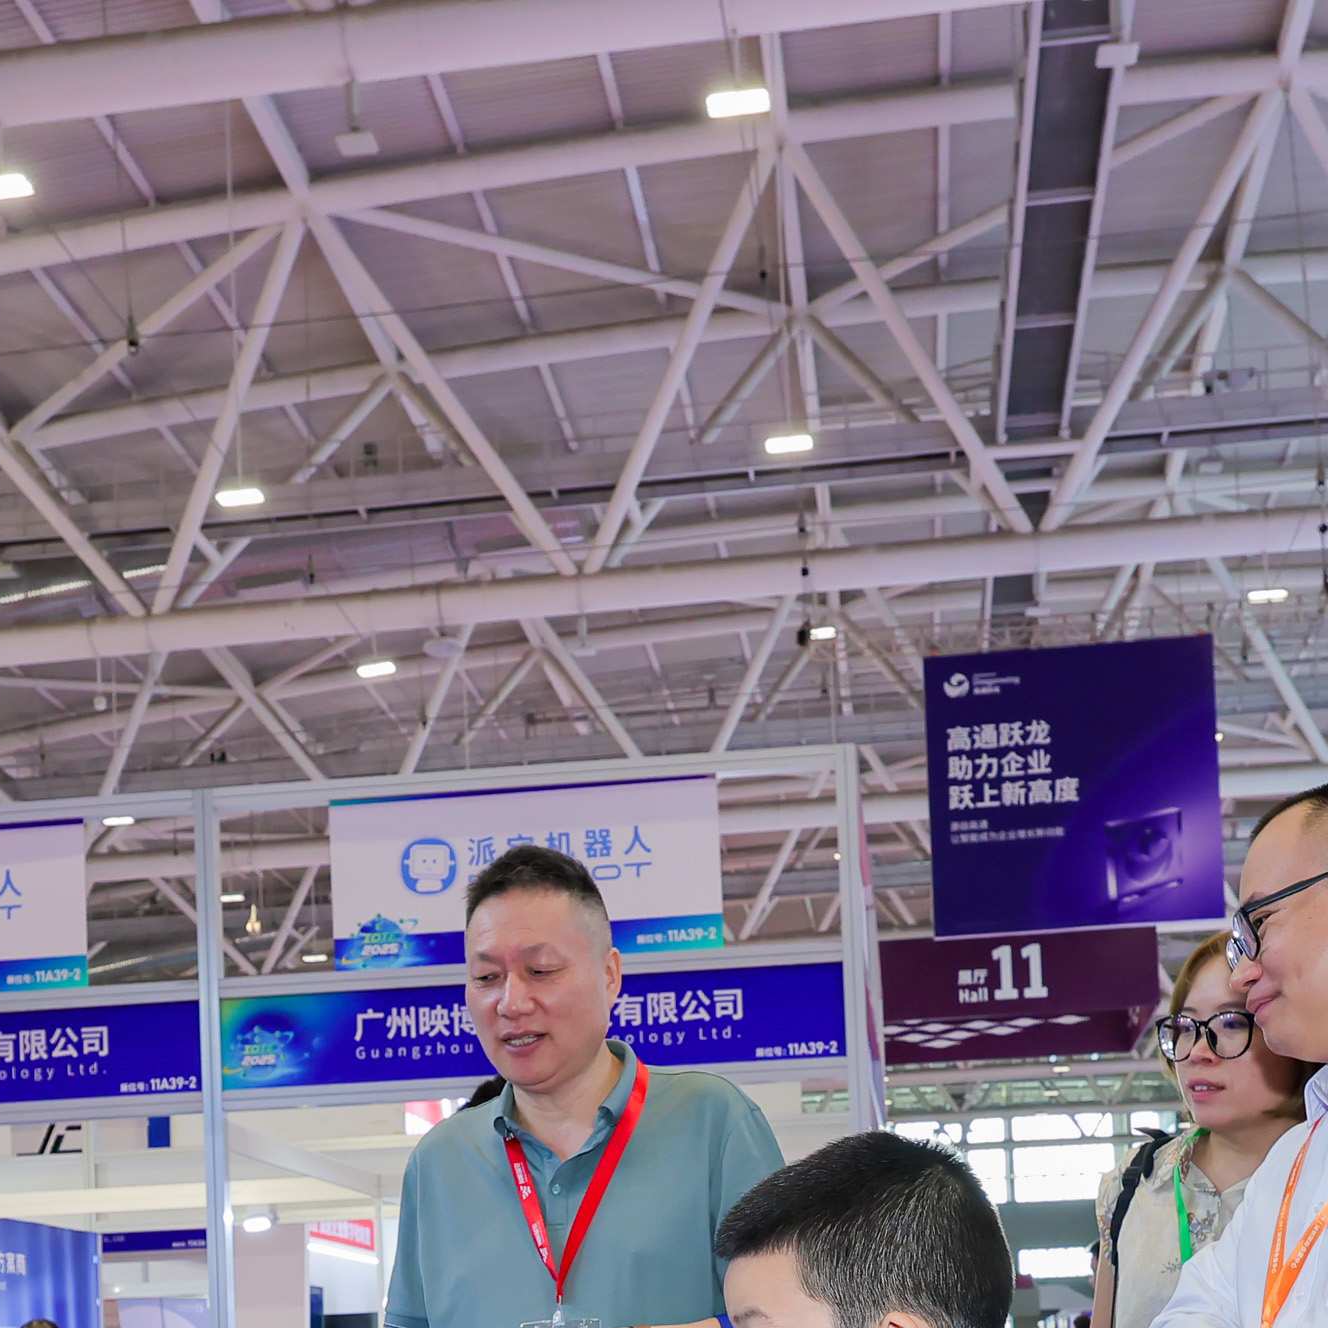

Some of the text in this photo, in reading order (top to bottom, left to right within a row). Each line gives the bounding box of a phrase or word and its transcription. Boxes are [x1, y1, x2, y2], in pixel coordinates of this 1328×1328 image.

[946, 719, 1052, 752] 高通跃龙
[947, 748, 1053, 781] 助力企业
[948, 776, 1080, 811] 跃上新高度
[668, 926, 719, 945] 11A39-2
[34, 967, 83, 985] 11A39-2
[990, 942, 1049, 1001] 11
[609, 988, 744, 1028] 有限公司
[958, 986, 989, 1004] Hall
[355, 1042, 474, 1060] Guangzhou
[698, 1025, 743, 1041] Ltd.
[787, 1040, 839, 1057] 11A39-2
[66, 1060, 108, 1078] Ltd.
[149, 1075, 198, 1092] 11A39-2
